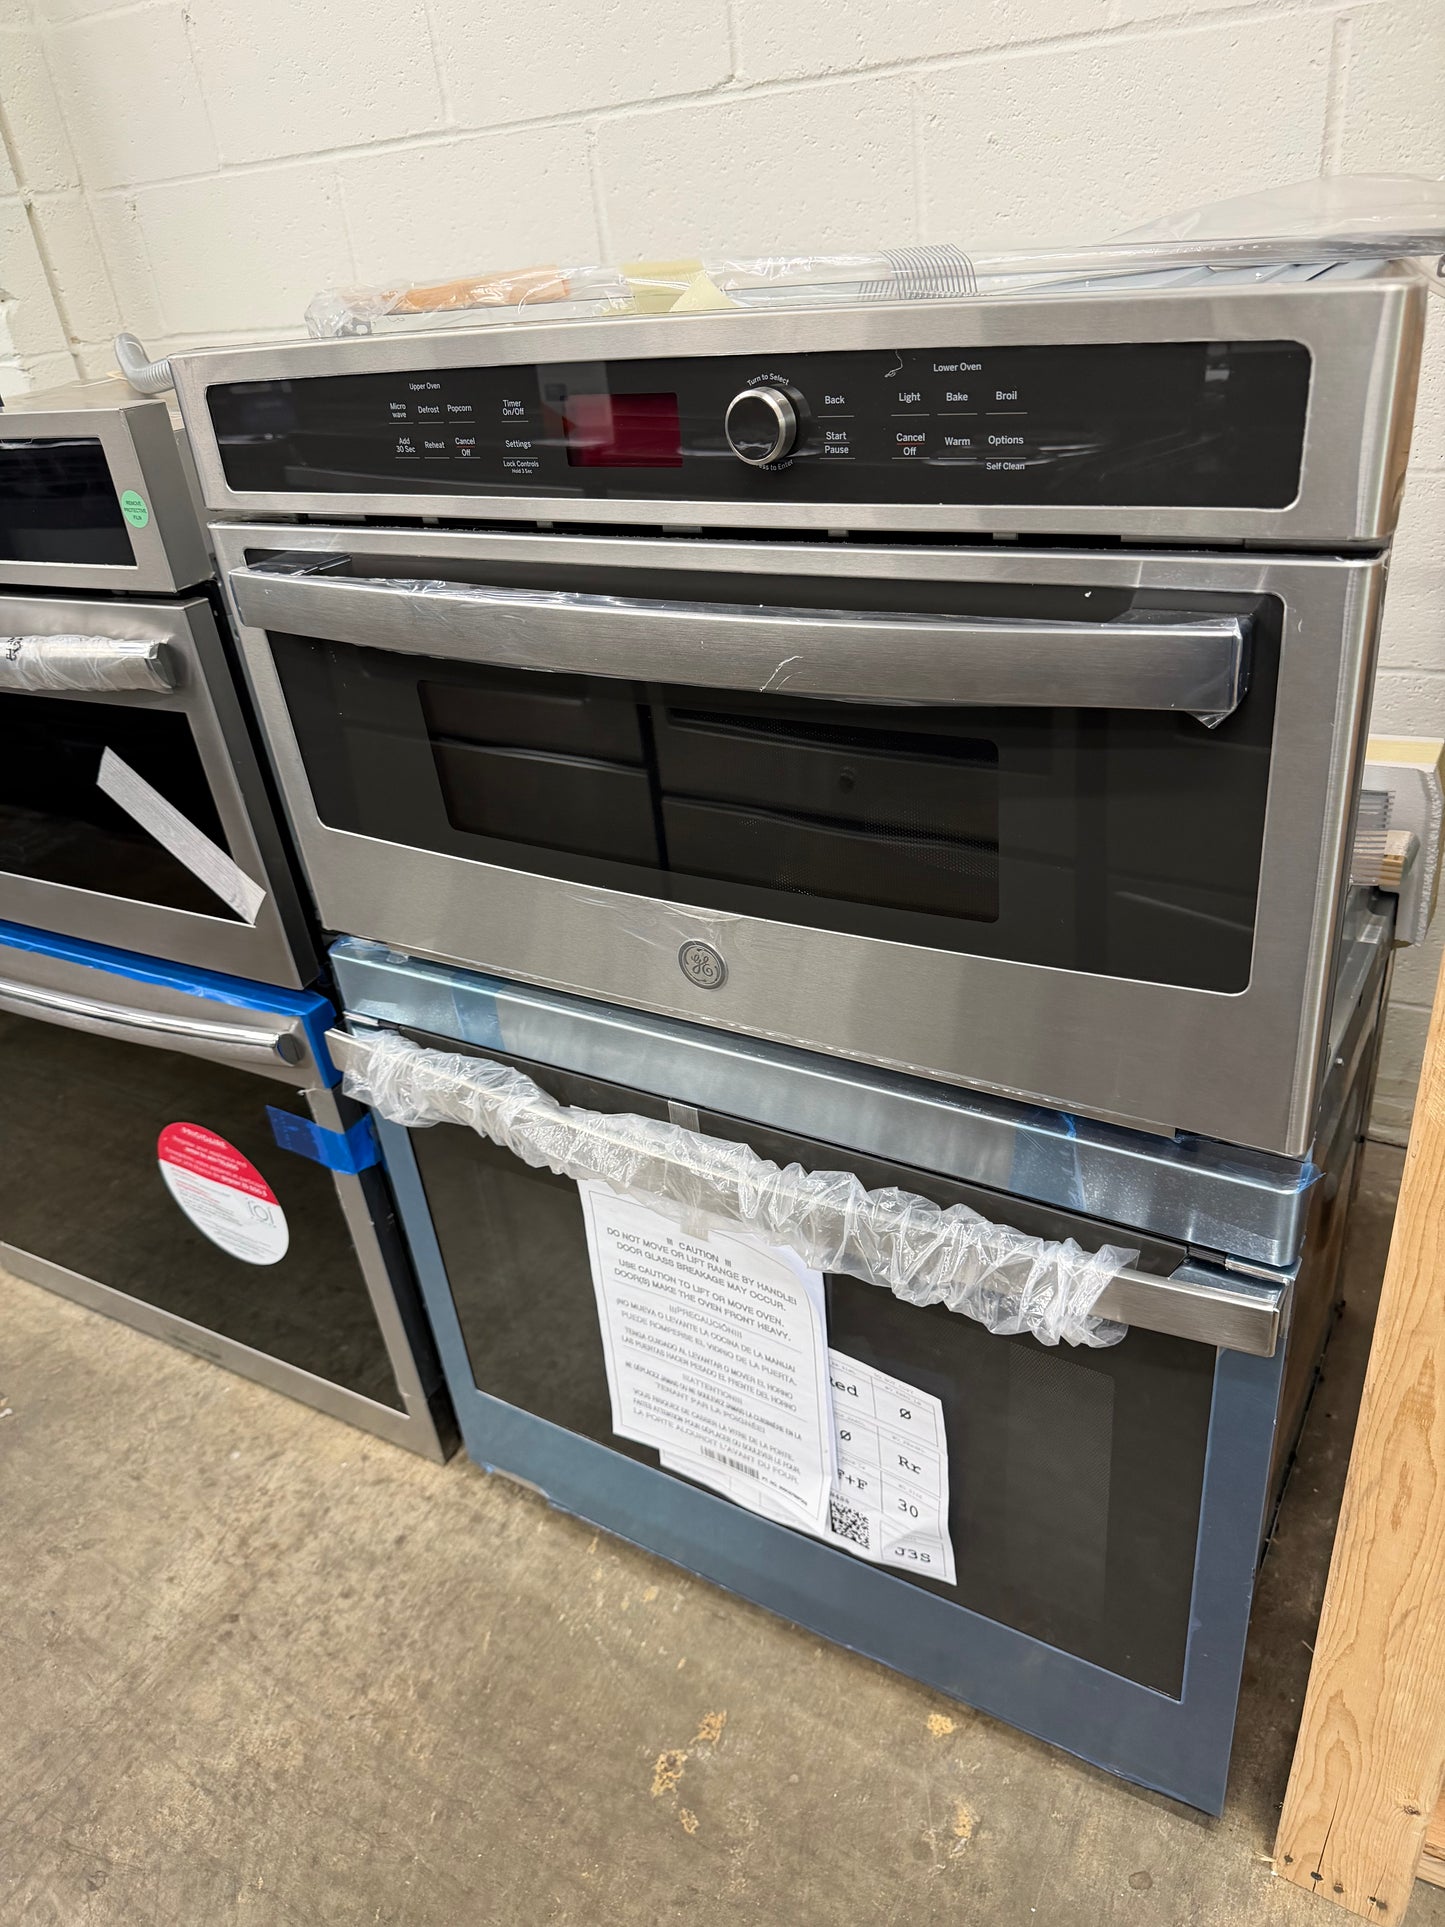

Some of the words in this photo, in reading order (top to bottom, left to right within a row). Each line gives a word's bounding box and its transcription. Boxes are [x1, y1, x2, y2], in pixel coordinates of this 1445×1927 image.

[933, 363, 959, 372] Lower
[959, 362, 982, 371] Oven
[747, 375, 761, 387] Turn
[769, 373, 790, 386] Select
[409, 383, 425, 391] Upper
[426, 382, 441, 390] Oven
[824, 395, 845, 405] Back
[898, 392, 921, 404] Light
[946, 392, 969, 402] Bake
[995, 391, 1018, 401] Broil
[390, 402, 407, 411] Micro
[503, 399, 521, 408] Timer
[417, 405, 440, 414] Defrost
[447, 404, 472, 413] Popcorn
[502, 408, 525, 416] On/Off
[825, 431, 847, 440] Start
[896, 432, 926, 442] Cancel
[399, 437, 411, 445] Add
[424, 441, 446, 450] Reheat
[454, 437, 476, 446] Cancel
[505, 440, 532, 449] Settings
[944, 437, 971, 446] Warm
[988, 435, 1024, 447] Options
[396, 445, 404, 453] 30
[404, 445, 416, 453] Sec
[461, 449, 471, 457] Off
[824, 445, 849, 454] Pause
[903, 446, 917, 456] Off
[503, 460, 516, 468] Lock
[516, 460, 540, 468] Controls
[778, 459, 794, 470] Enter
[986, 462, 1002, 471] Self
[1002, 462, 1026, 471] Clean
[607, 1226, 619, 1237] DO
[622, 1232, 640, 1244] NOT
[643, 1239, 668, 1254] MOVE
[671, 1249, 684, 1259] OR
[686, 1255, 705, 1267] LIFT
[707, 1263, 739, 1280] RANGE
[742, 1276, 754, 1286] BY
[678, 1242, 718, 1262] CAUTION
[616, 1241, 642, 1256] DOOR
[644, 1251, 674, 1267] GLASS
[676, 1262, 724, 1286] BREAKAGE
[727, 1281, 747, 1294] MAY
[749, 1290, 785, 1311] OCCUR.
[619, 1258, 636, 1270] USE
[638, 1265, 675, 1283] CAUTION
[678, 1279, 690, 1289] TO
[692, 1285, 709, 1297] LIFT
[712, 1292, 724, 1303] OR
[727, 1298, 753, 1314] MOVE
[755, 1309, 784, 1327] OVEN.
[652, 1281, 676, 1295] MAKE
[678, 1290, 695, 1302] THE
[697, 1297, 721, 1312] OVEN
[724, 1308, 755, 1326] FRONT
[757, 1321, 791, 1341] HEAVY.
[897, 1454, 922, 1475] Rr
[898, 1498, 919, 1518] 30
